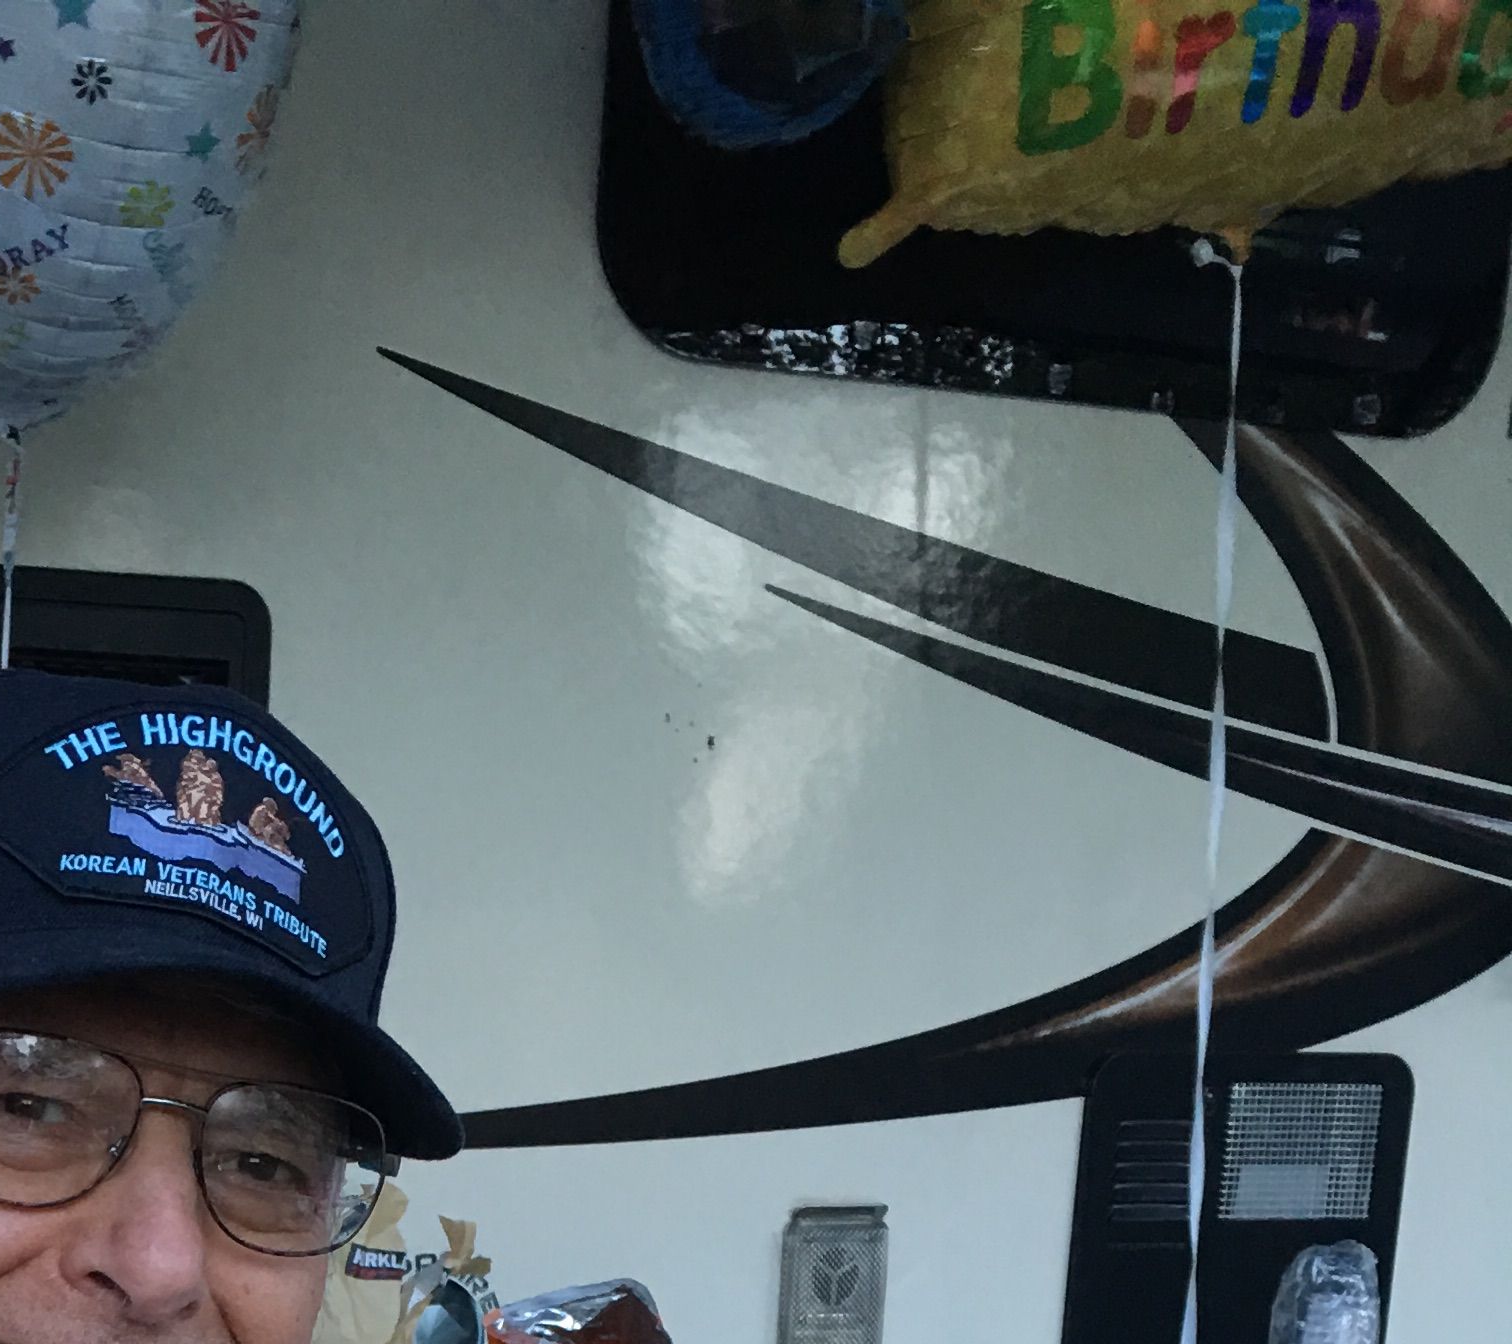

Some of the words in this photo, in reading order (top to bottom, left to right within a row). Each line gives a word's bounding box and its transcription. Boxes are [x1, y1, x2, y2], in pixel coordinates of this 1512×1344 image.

[44, 721, 128, 771] THE
[140, 713, 346, 860] HIGHGROUND
[59, 853, 147, 877] KOREAN
[157, 861, 257, 911] VETERANS
[263, 899, 329, 959] TRIBUTE
[144, 878, 243, 922] NEILLSVILLE,
[245, 910, 264, 931] WI
